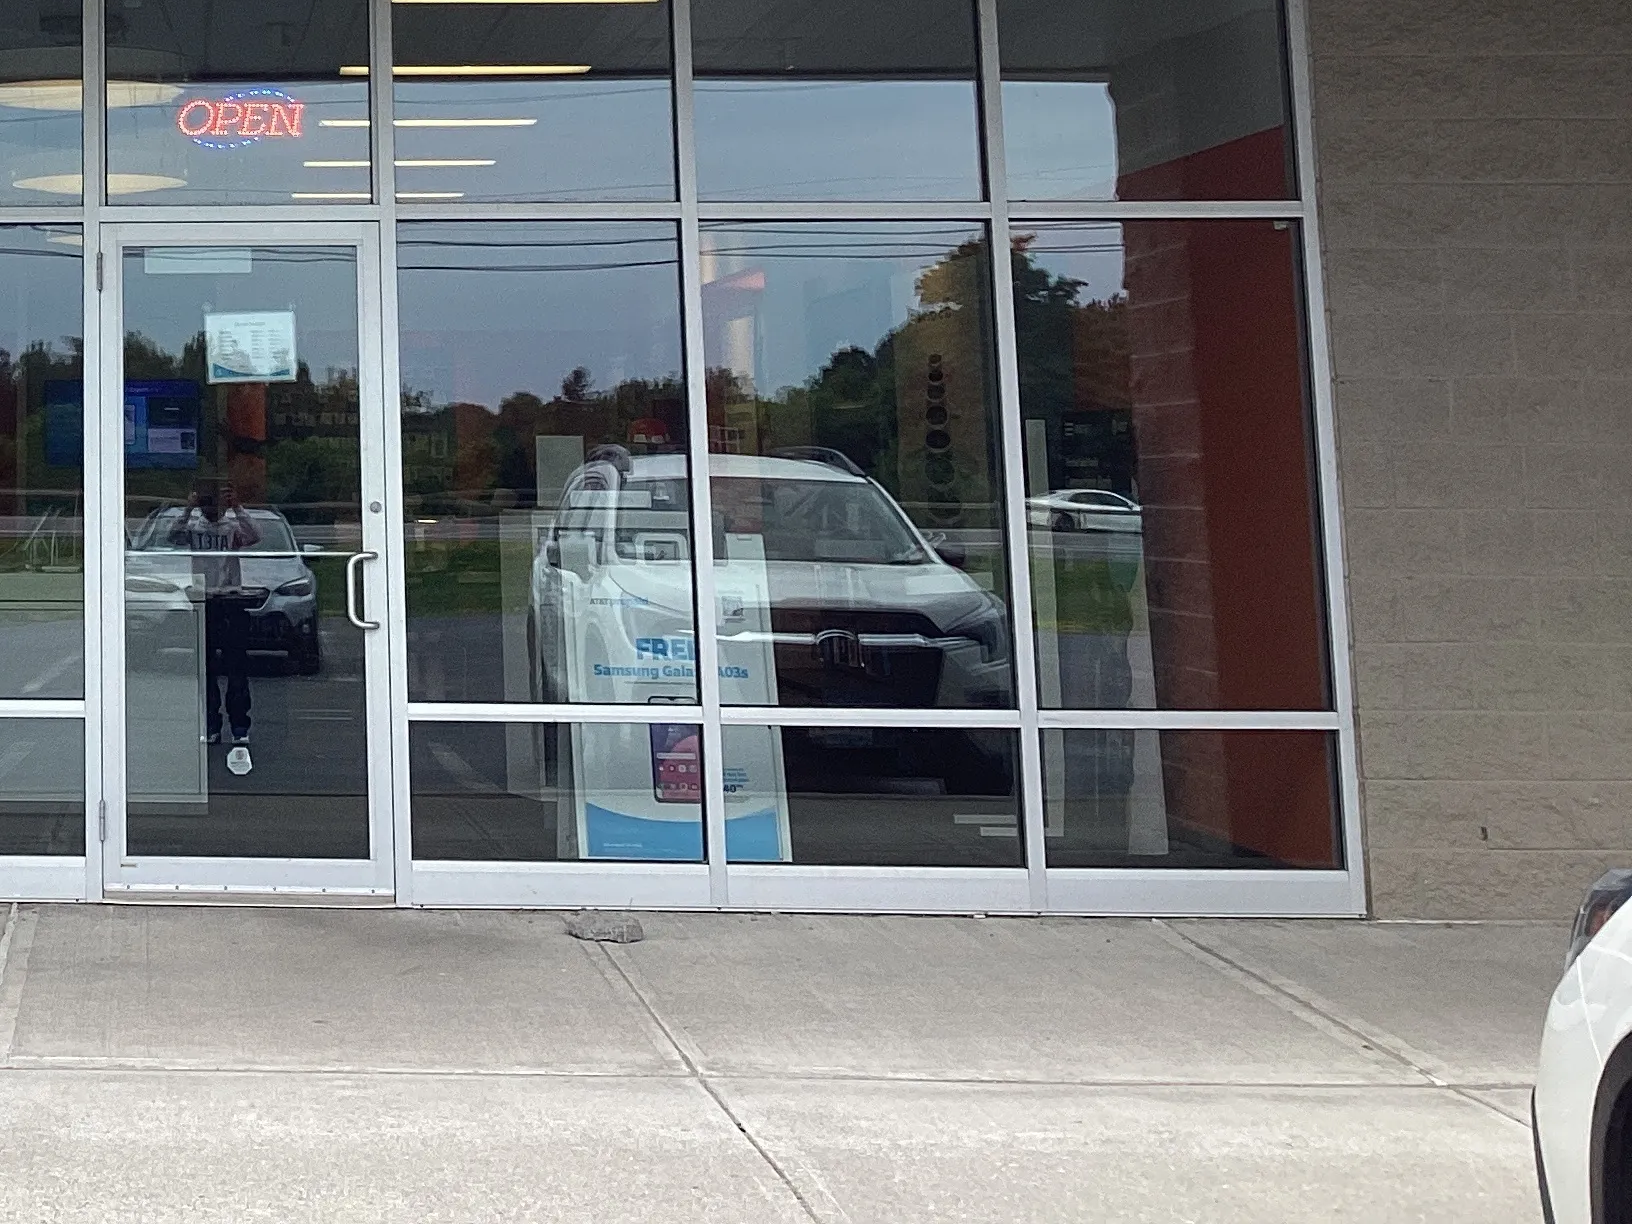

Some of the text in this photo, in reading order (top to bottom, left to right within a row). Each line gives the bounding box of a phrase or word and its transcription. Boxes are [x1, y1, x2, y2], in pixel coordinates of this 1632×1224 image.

[177, 99, 305, 138] OPEN
[593, 663, 659, 680] Samsung
[662, 665, 695, 678] Gala
